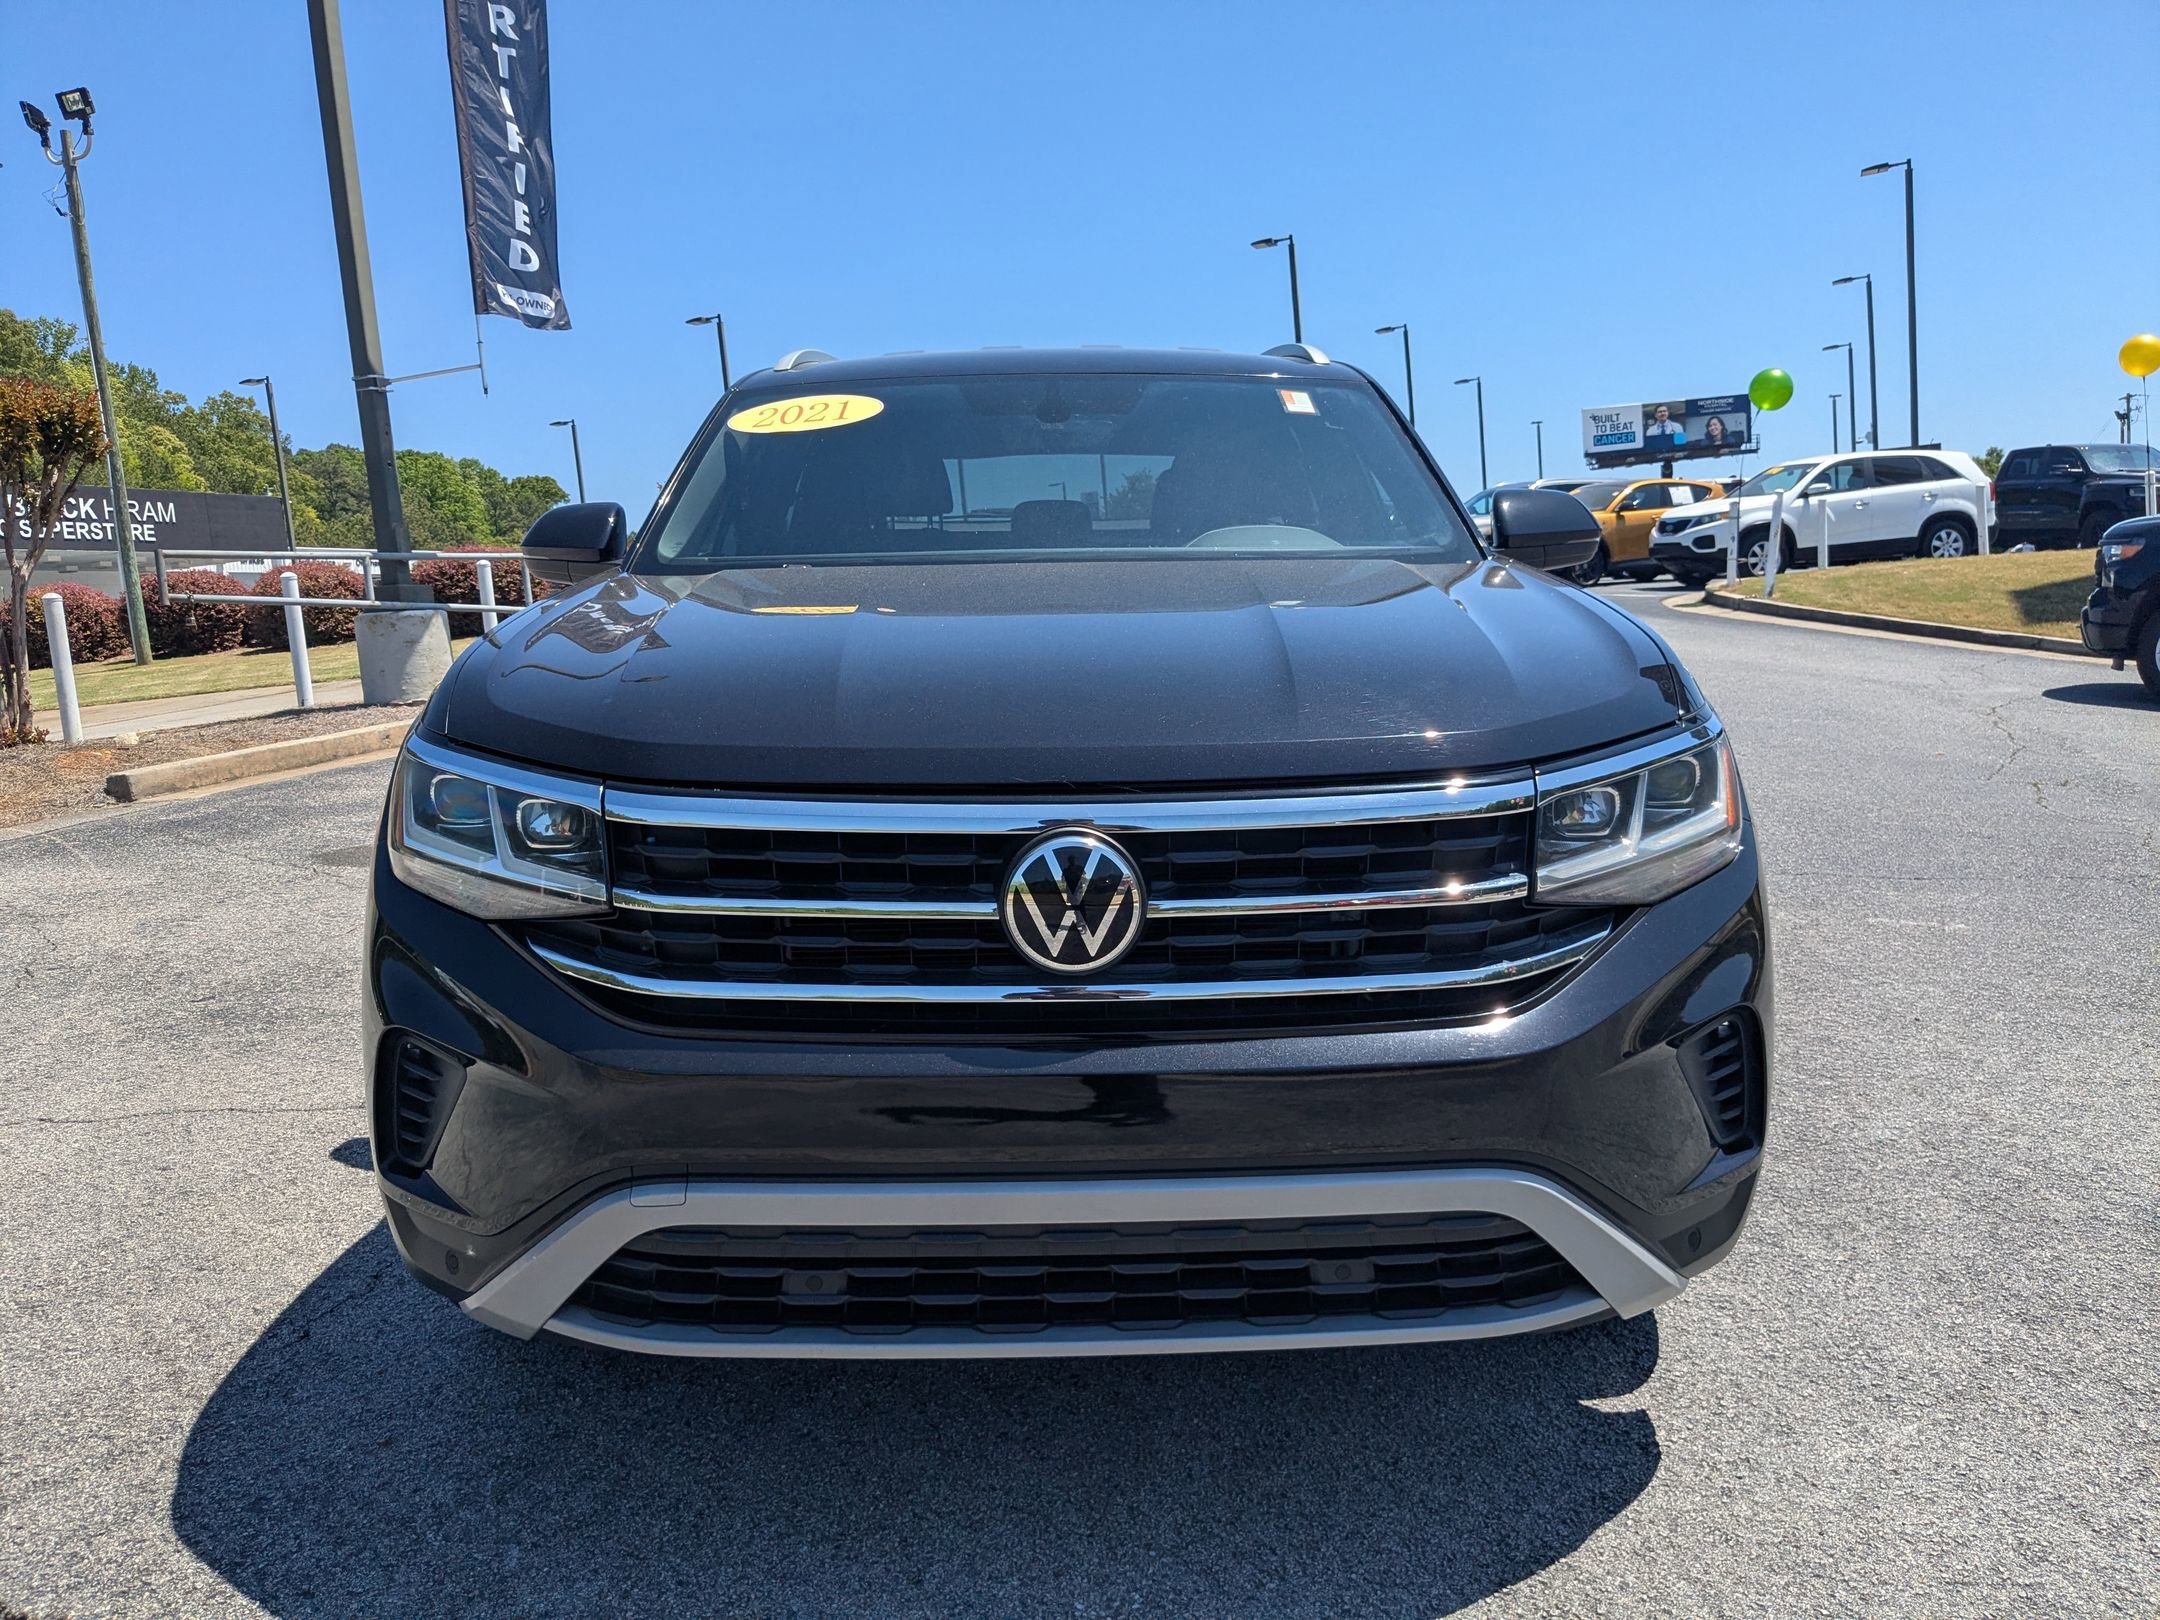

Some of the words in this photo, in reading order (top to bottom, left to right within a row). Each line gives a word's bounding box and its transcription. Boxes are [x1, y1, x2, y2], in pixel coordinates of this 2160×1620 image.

[752, 400, 849, 429] 2021
[1594, 413, 1621, 425] BUILT
[1595, 424, 1607, 434] TO
[1609, 421, 1634, 433] BEAT
[1594, 432, 1635, 445] CANCER
[102, 498, 177, 523] HRAM
[19, 519, 157, 542] SPERSTRE
